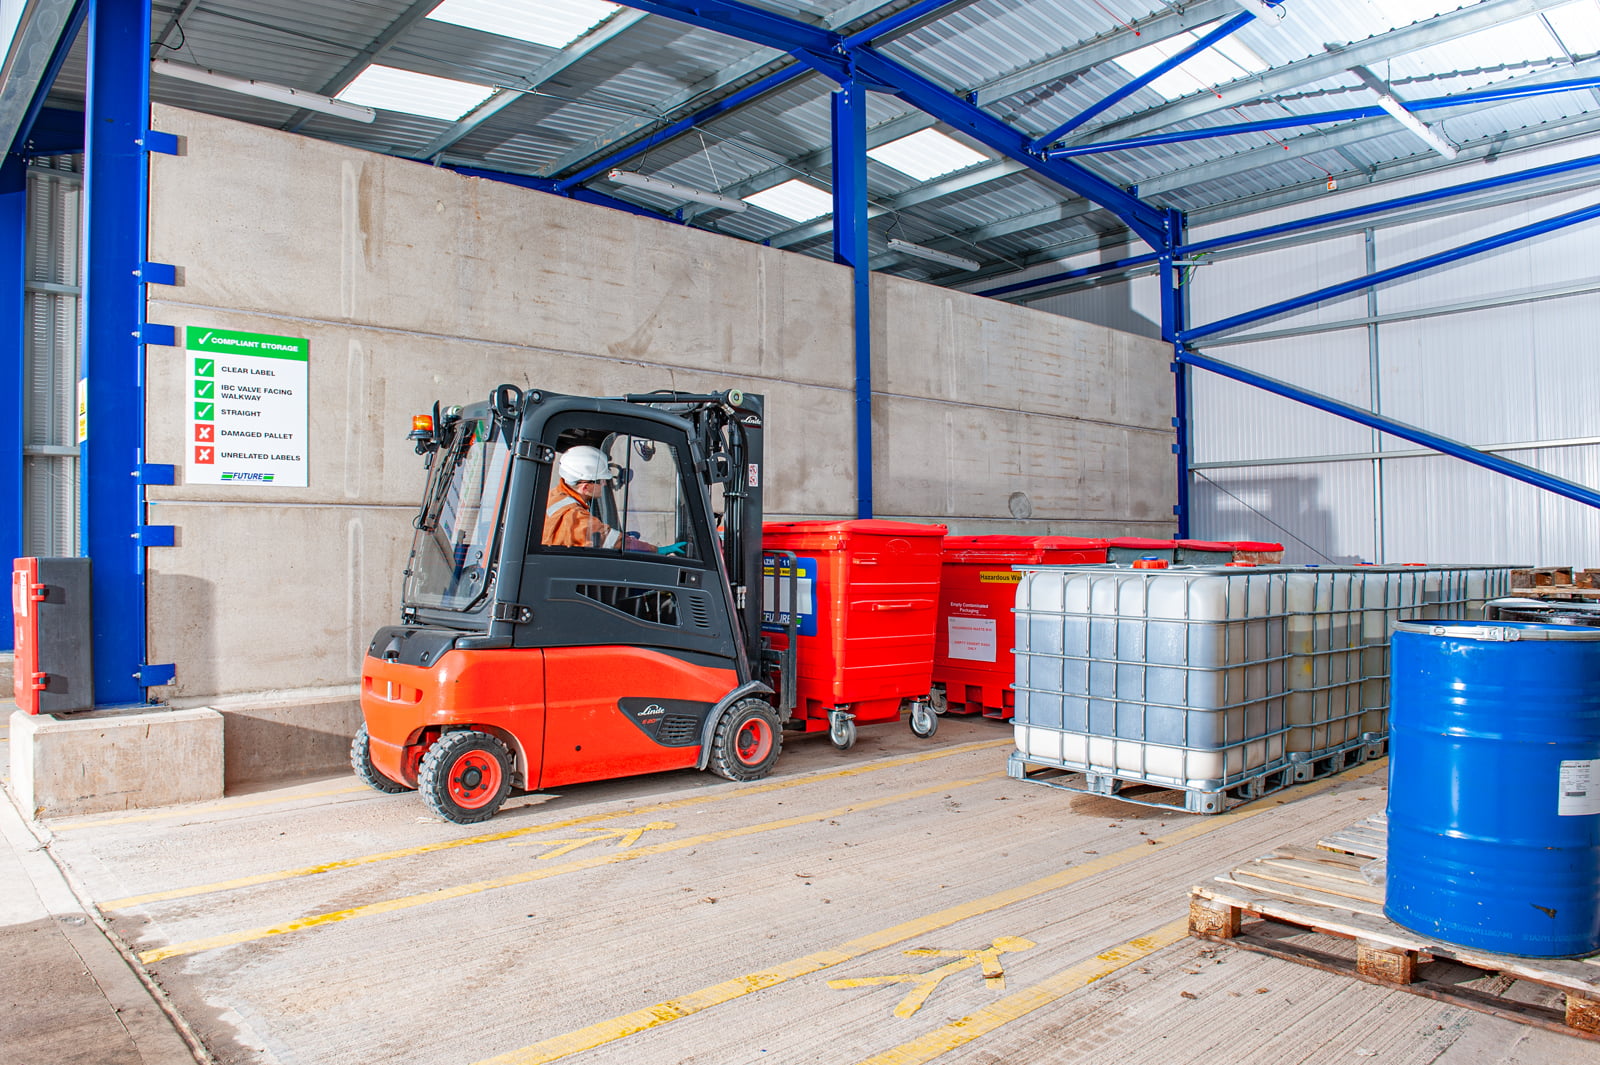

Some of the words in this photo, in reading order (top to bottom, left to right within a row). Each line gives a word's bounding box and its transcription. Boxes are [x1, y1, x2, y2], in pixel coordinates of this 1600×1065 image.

[211, 337, 259, 348] COMPLIANT
[261, 342, 299, 352] STORAGE
[221, 366, 249, 374] CLEAR
[250, 369, 276, 377] LABEL
[237, 385, 261, 393] VALVE
[263, 387, 293, 396] FACING
[221, 393, 261, 401] WALKWAY
[221, 409, 261, 417] STRAIGHT
[740, 415, 762, 424] Linde
[221, 430, 262, 438] DAMAGED
[264, 432, 293, 440] PALLET
[221, 452, 269, 460] UNRELATED
[270, 454, 301, 462] LABELS
[232, 472, 263, 480] FUTURE
[765, 613, 790, 624] FUURE
[637, 704, 665, 716] Linde
